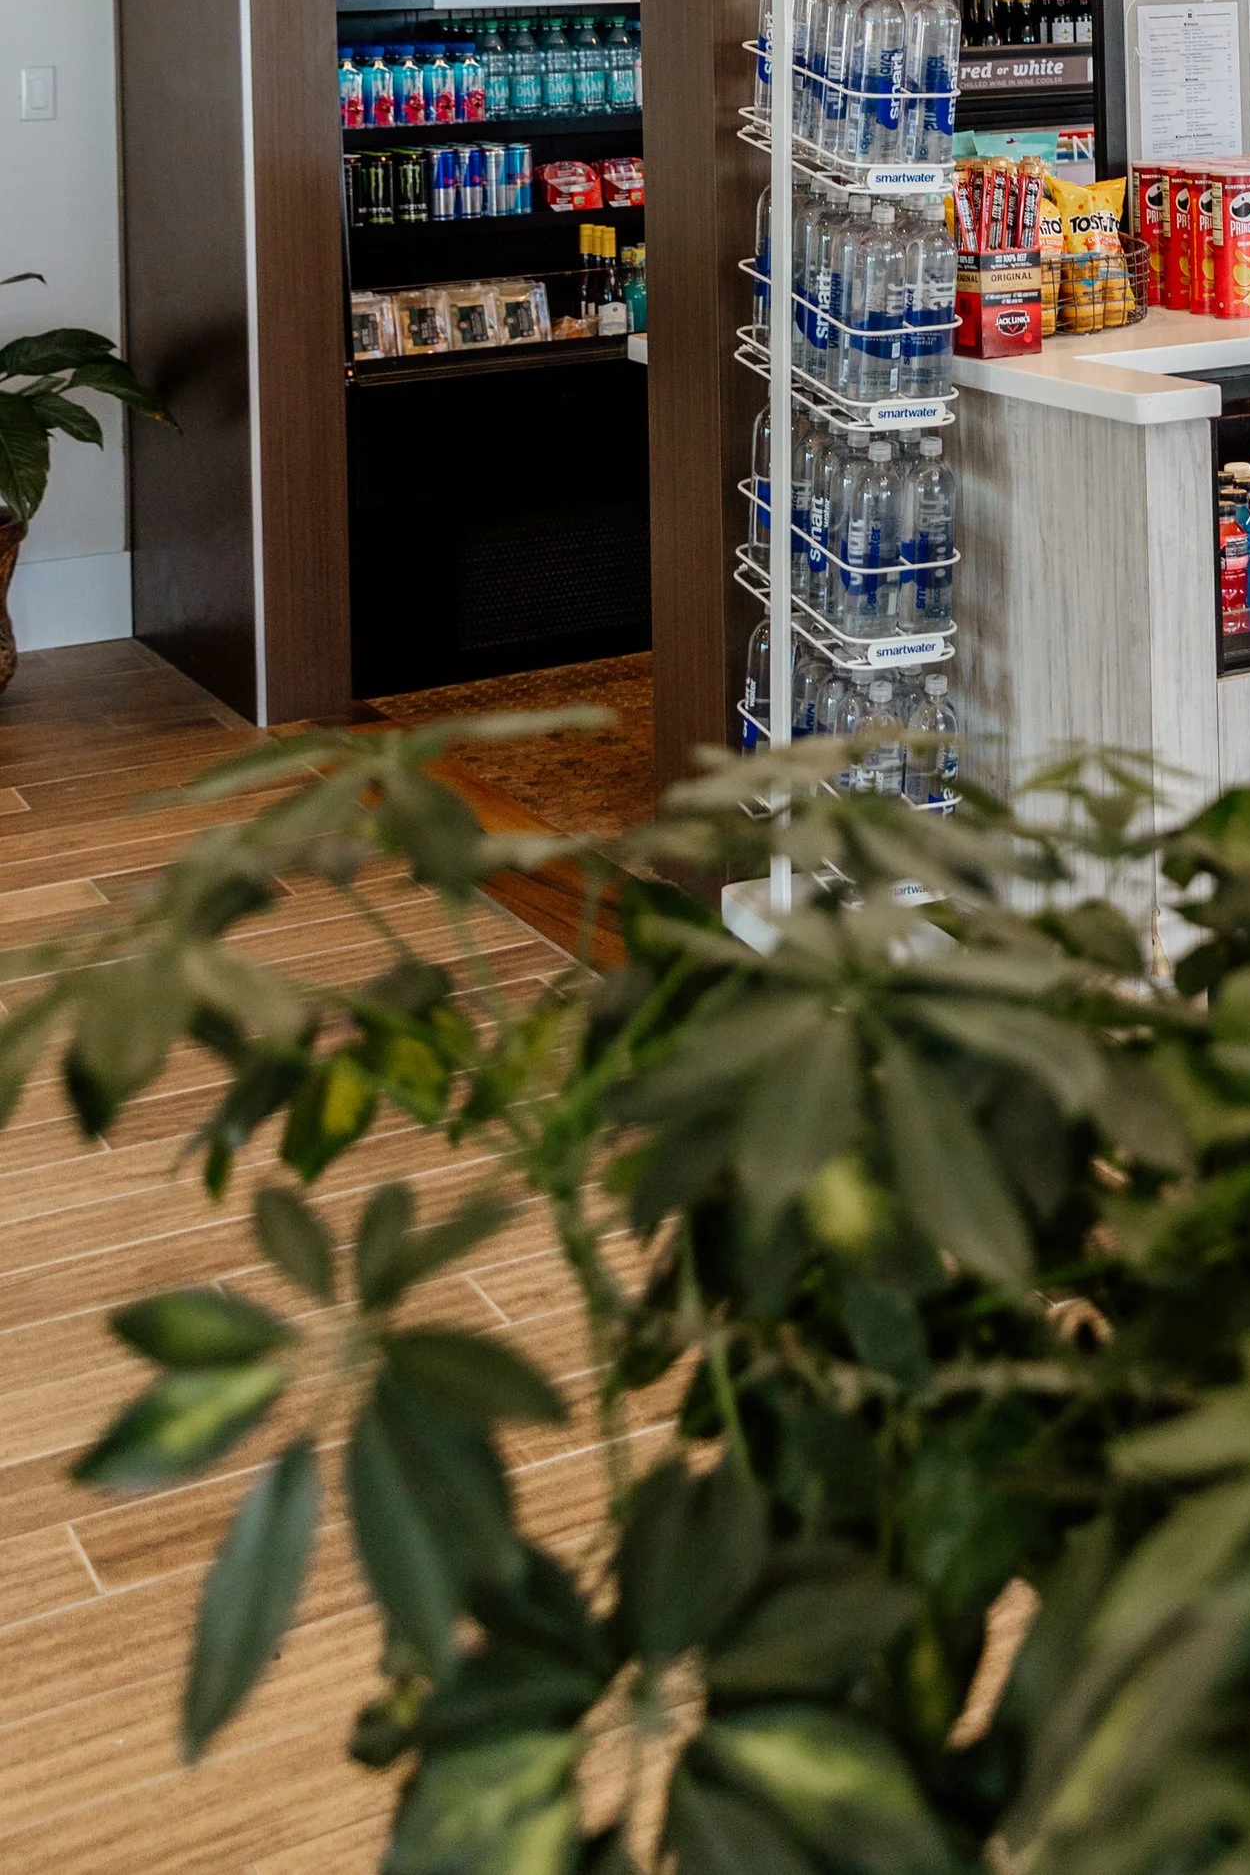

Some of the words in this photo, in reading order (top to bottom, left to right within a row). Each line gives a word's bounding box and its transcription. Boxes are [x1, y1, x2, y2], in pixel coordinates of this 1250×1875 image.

[961, 62, 993, 79] red
[996, 67, 1010, 75] or
[1013, 59, 1065, 76] white
[890, 51, 904, 120] smart
[1036, 76, 1064, 84] COOLER
[875, 172, 936, 184] smartwater
[991, 272, 1033, 283] ORIGINAL
[816, 266, 832, 340] smart
[995, 316, 1012, 326] JACK
[878, 408, 938, 419] smartwater
[810, 496, 824, 562] smart
[876, 643, 937, 657] smartwater
[749, 678, 758, 707] water
